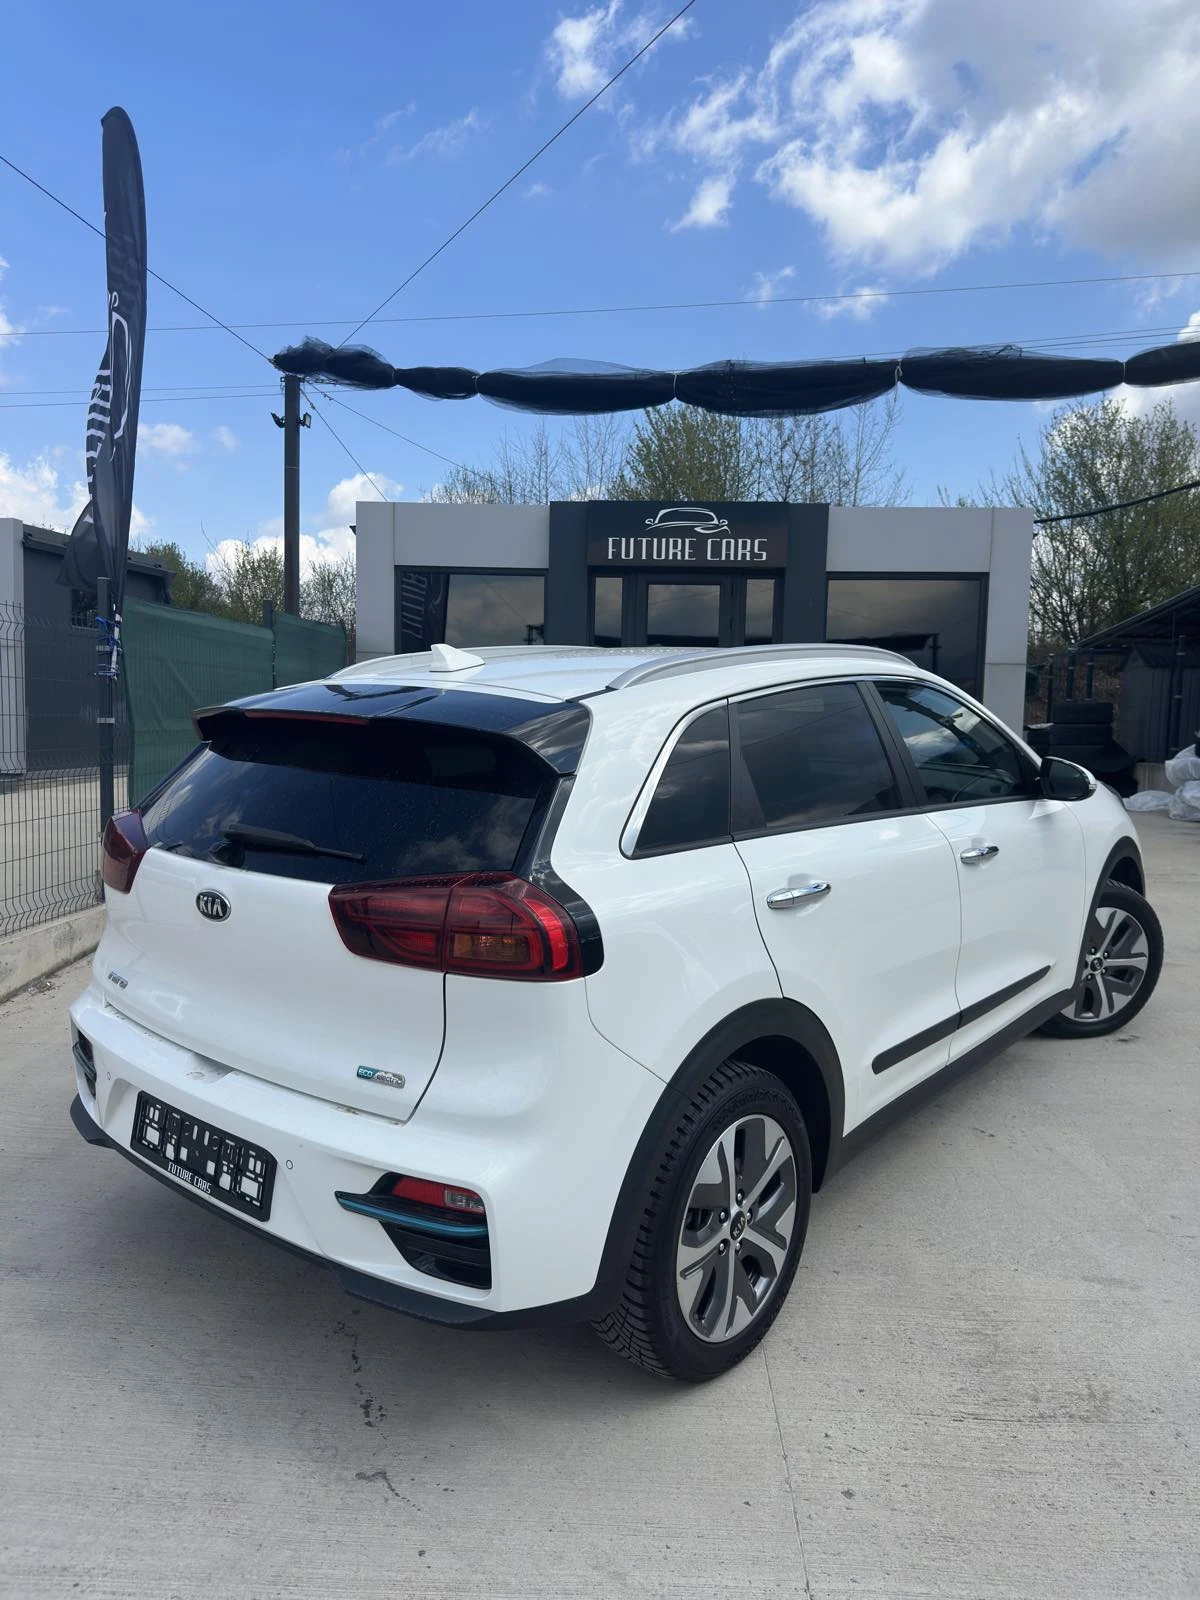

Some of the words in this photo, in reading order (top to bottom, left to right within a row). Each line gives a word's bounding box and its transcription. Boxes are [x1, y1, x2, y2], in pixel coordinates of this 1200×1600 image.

[607, 537, 697, 561] FUTURE
[706, 538, 768, 561] CARS
[199, 895, 223, 917] KIA
[167, 1161, 194, 1184] FUTURE
[193, 1175, 212, 1194] CARS
